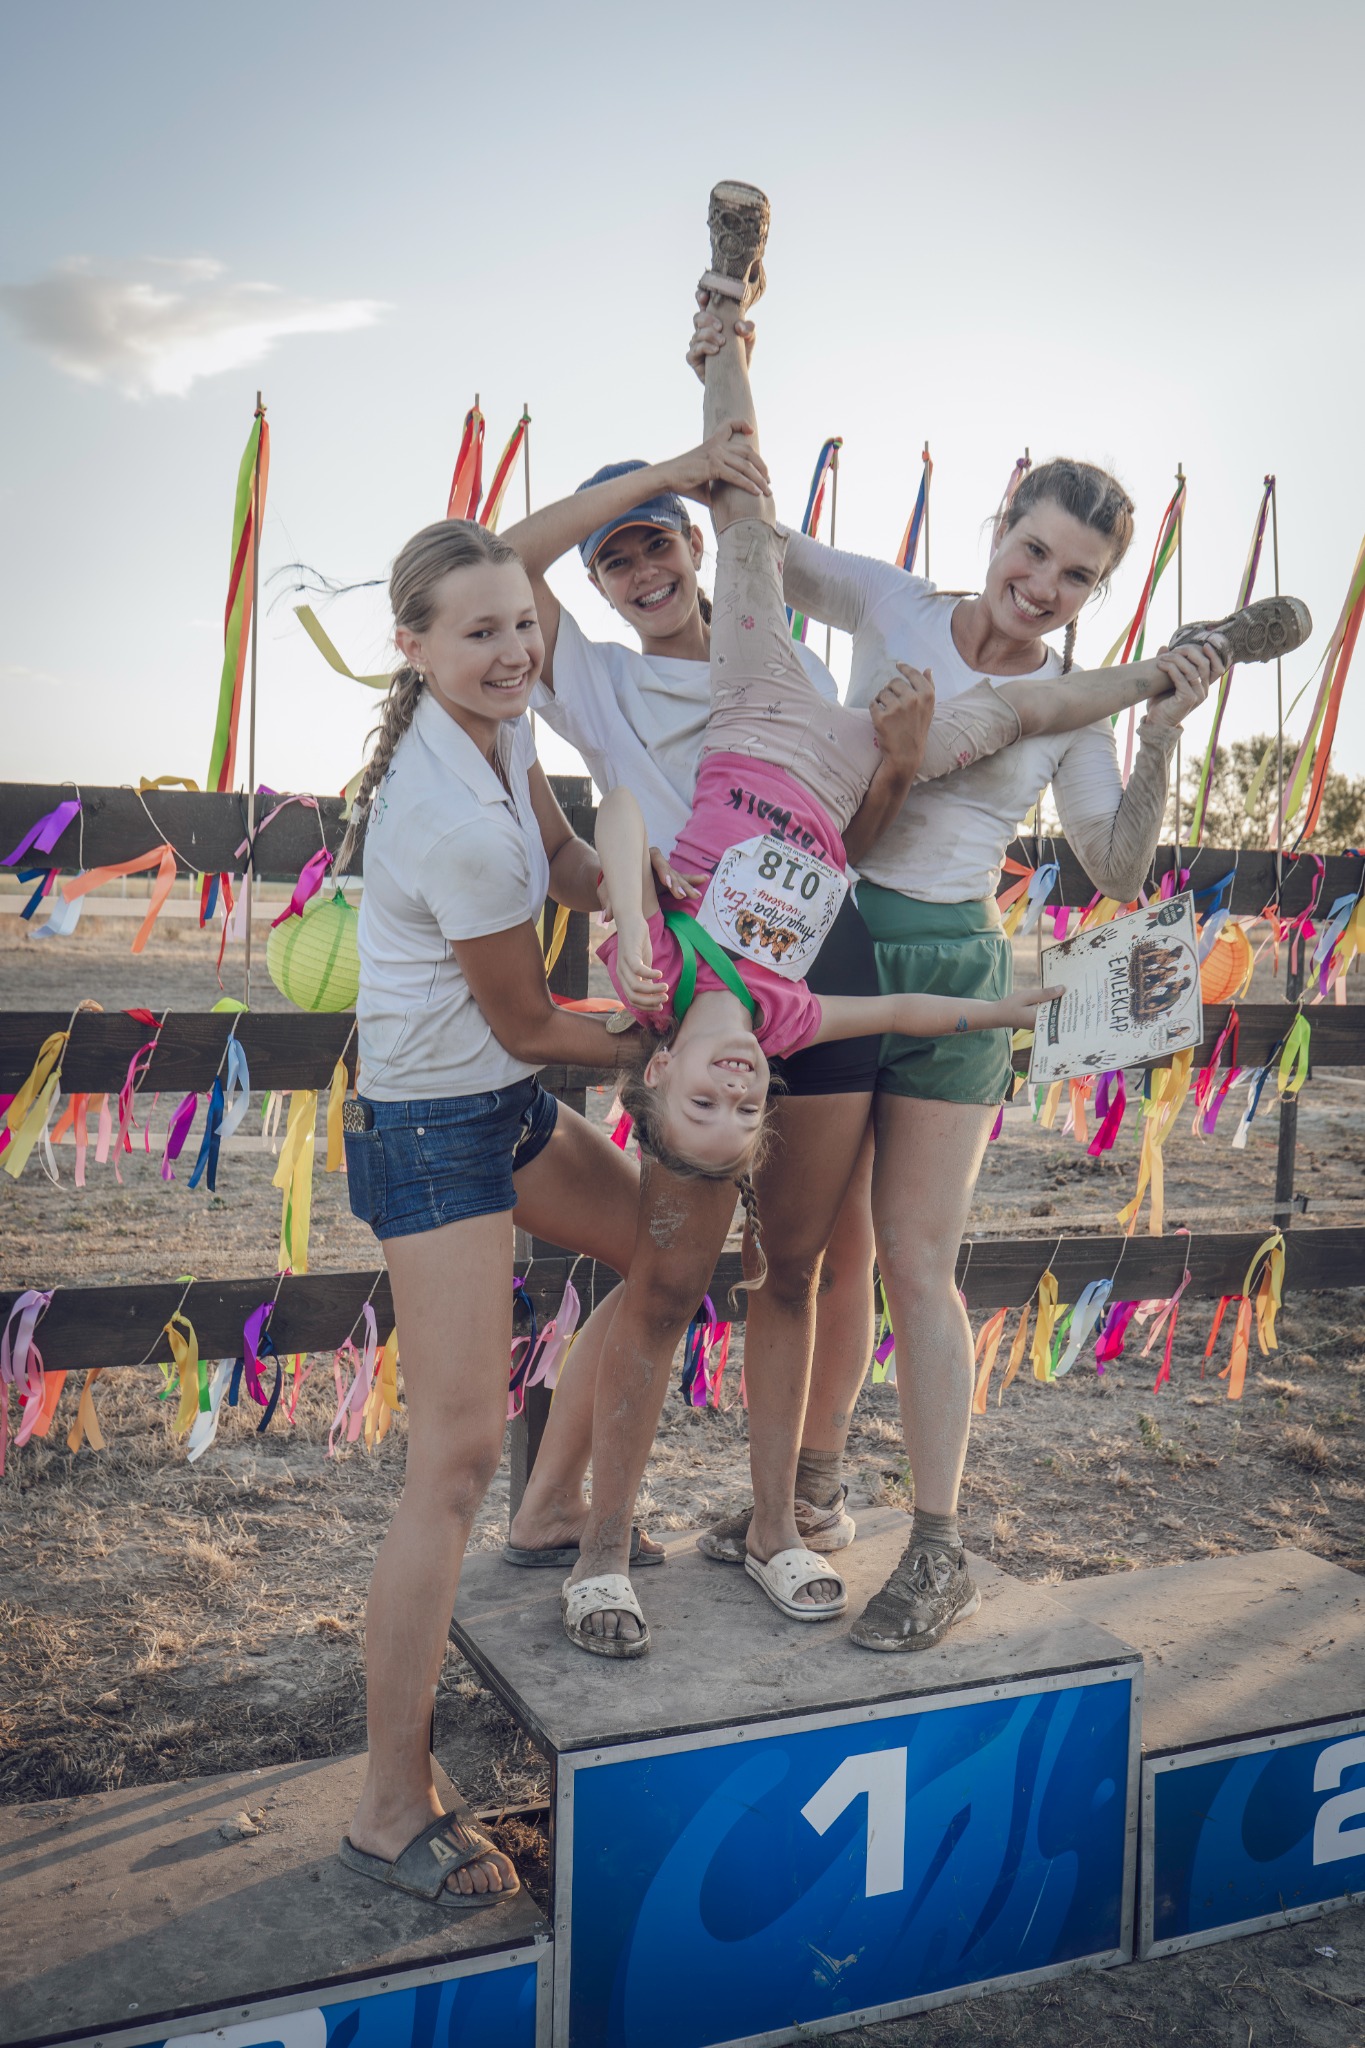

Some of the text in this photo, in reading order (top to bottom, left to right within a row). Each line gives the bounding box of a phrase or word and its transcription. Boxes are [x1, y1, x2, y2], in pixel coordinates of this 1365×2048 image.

[757, 850, 820, 900] 018
[754, 901, 815, 944] Anya/Apa
[757, 890, 797, 914] verseny
[800, 1746, 908, 1898] 1
